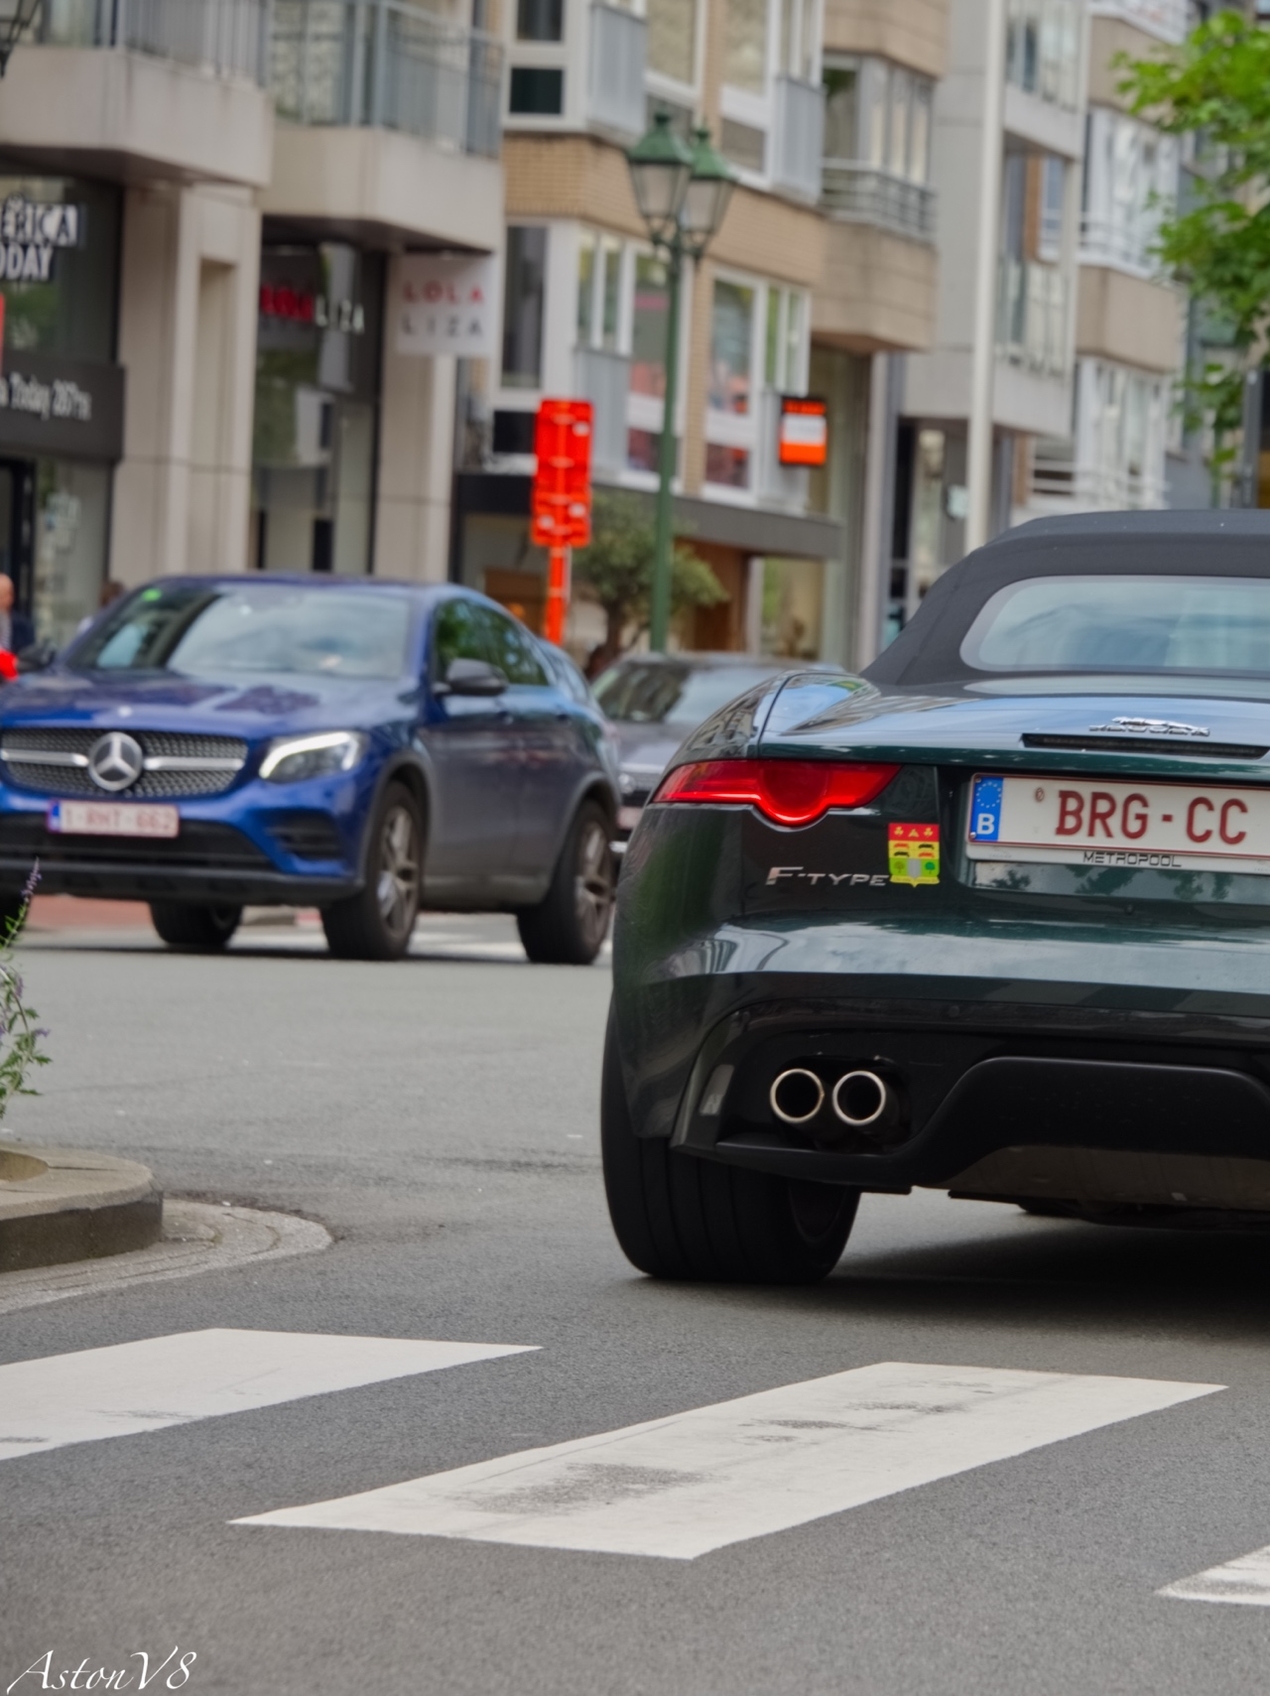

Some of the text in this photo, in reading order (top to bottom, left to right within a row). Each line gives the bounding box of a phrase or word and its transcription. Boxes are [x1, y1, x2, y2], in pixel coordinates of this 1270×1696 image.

[403, 280, 484, 305] LOLA
[402, 313, 483, 337] LIZA
[977, 790, 1249, 845] B BRG-CC
[1083, 851, 1182, 868] METROPOOL
[766, 866, 889, 886] F-TYPE
